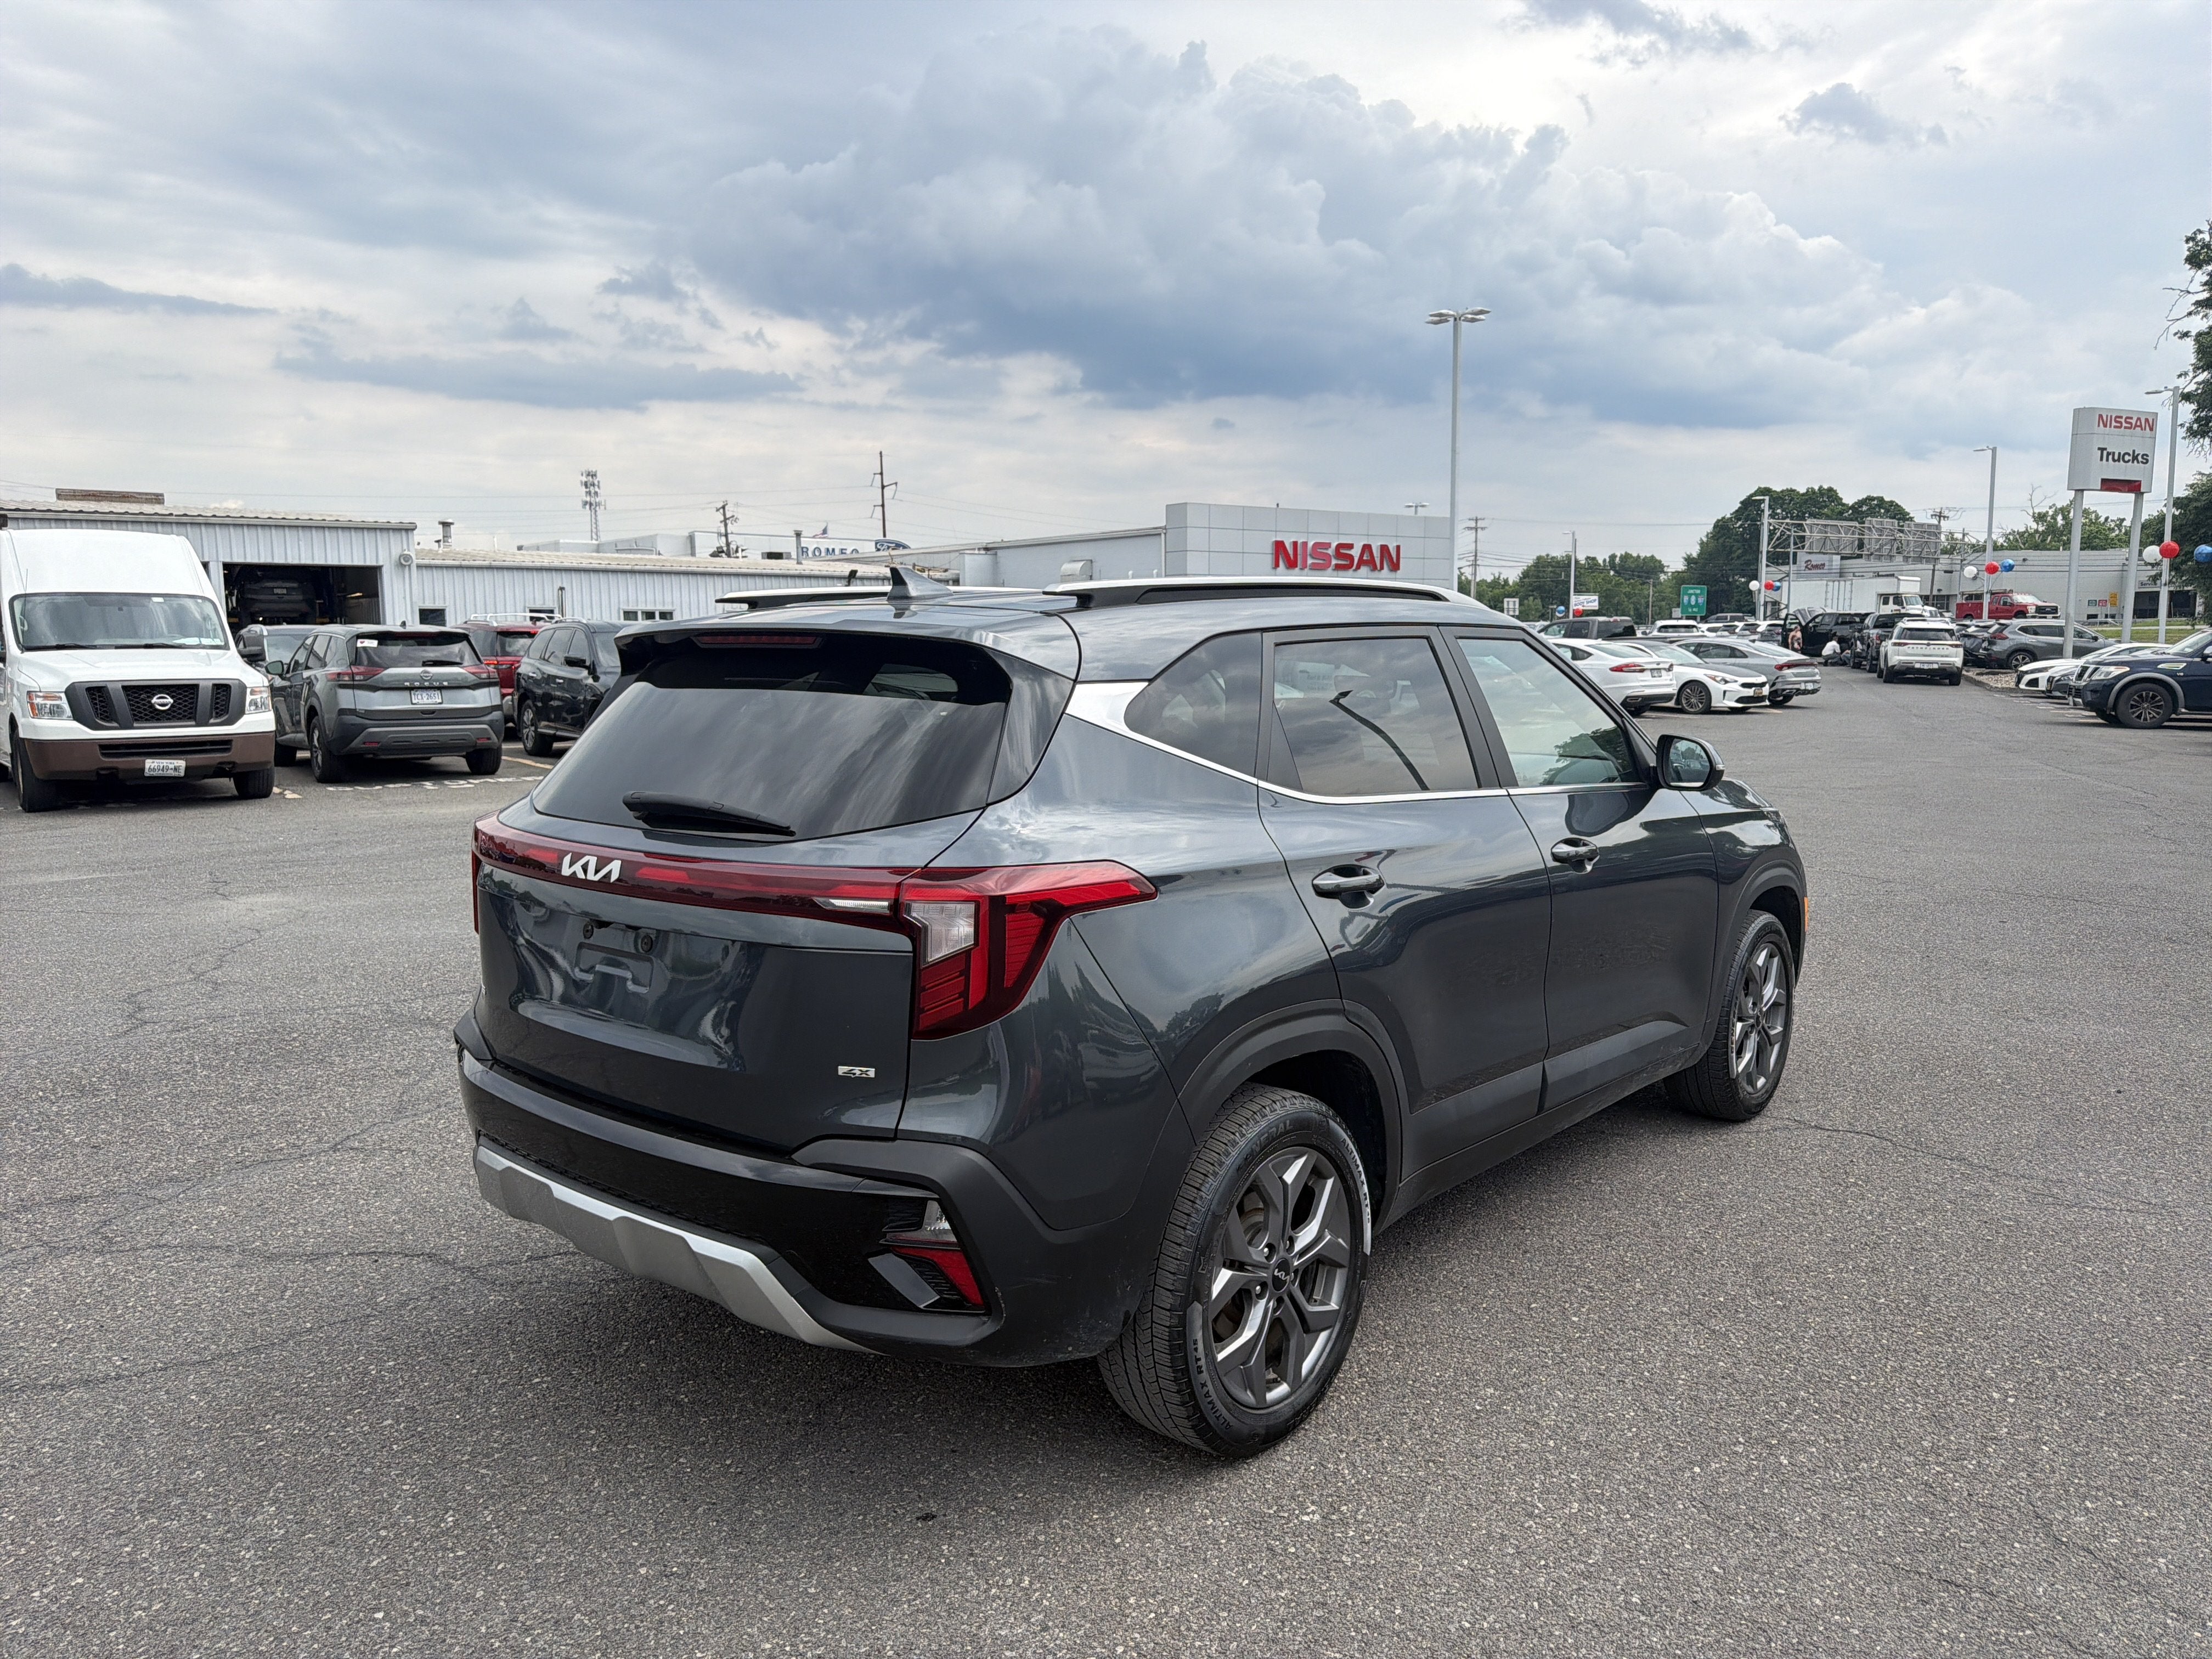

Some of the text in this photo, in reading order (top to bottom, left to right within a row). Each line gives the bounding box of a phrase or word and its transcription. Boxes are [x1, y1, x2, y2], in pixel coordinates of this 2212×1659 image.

[2097, 414, 2154, 431] NISSAN
[2097, 447, 2149, 465] Trucks
[802, 546, 859, 557] ROMEO
[1273, 540, 1401, 571] NISSAN
[1804, 559, 1826, 571] Romeo
[561, 852, 622, 883] KIA
[1237, 1119, 1294, 1177] ENERAL
[1340, 1137, 1365, 1188] ALTIMAX
[1202, 1382, 1233, 1430] ALTIMAX
